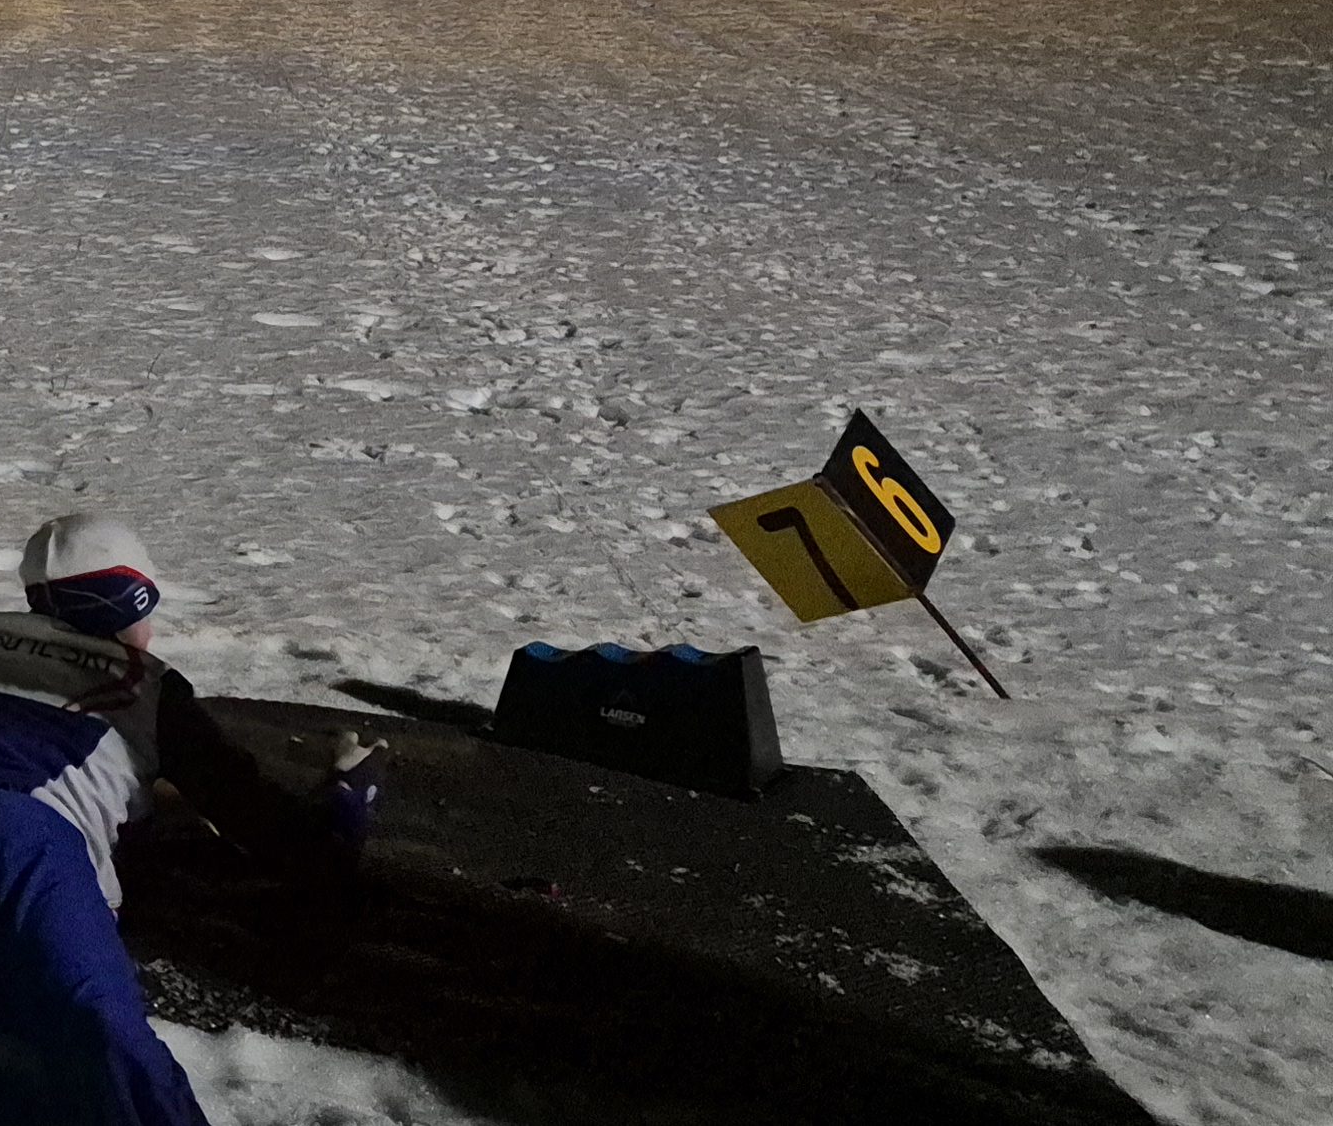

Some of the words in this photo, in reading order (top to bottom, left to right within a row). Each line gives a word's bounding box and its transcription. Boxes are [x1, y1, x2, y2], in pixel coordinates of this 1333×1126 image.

[852, 445, 941, 553] 6
[757, 506, 860, 611] 7
[599, 706, 646, 724] LARSEN
